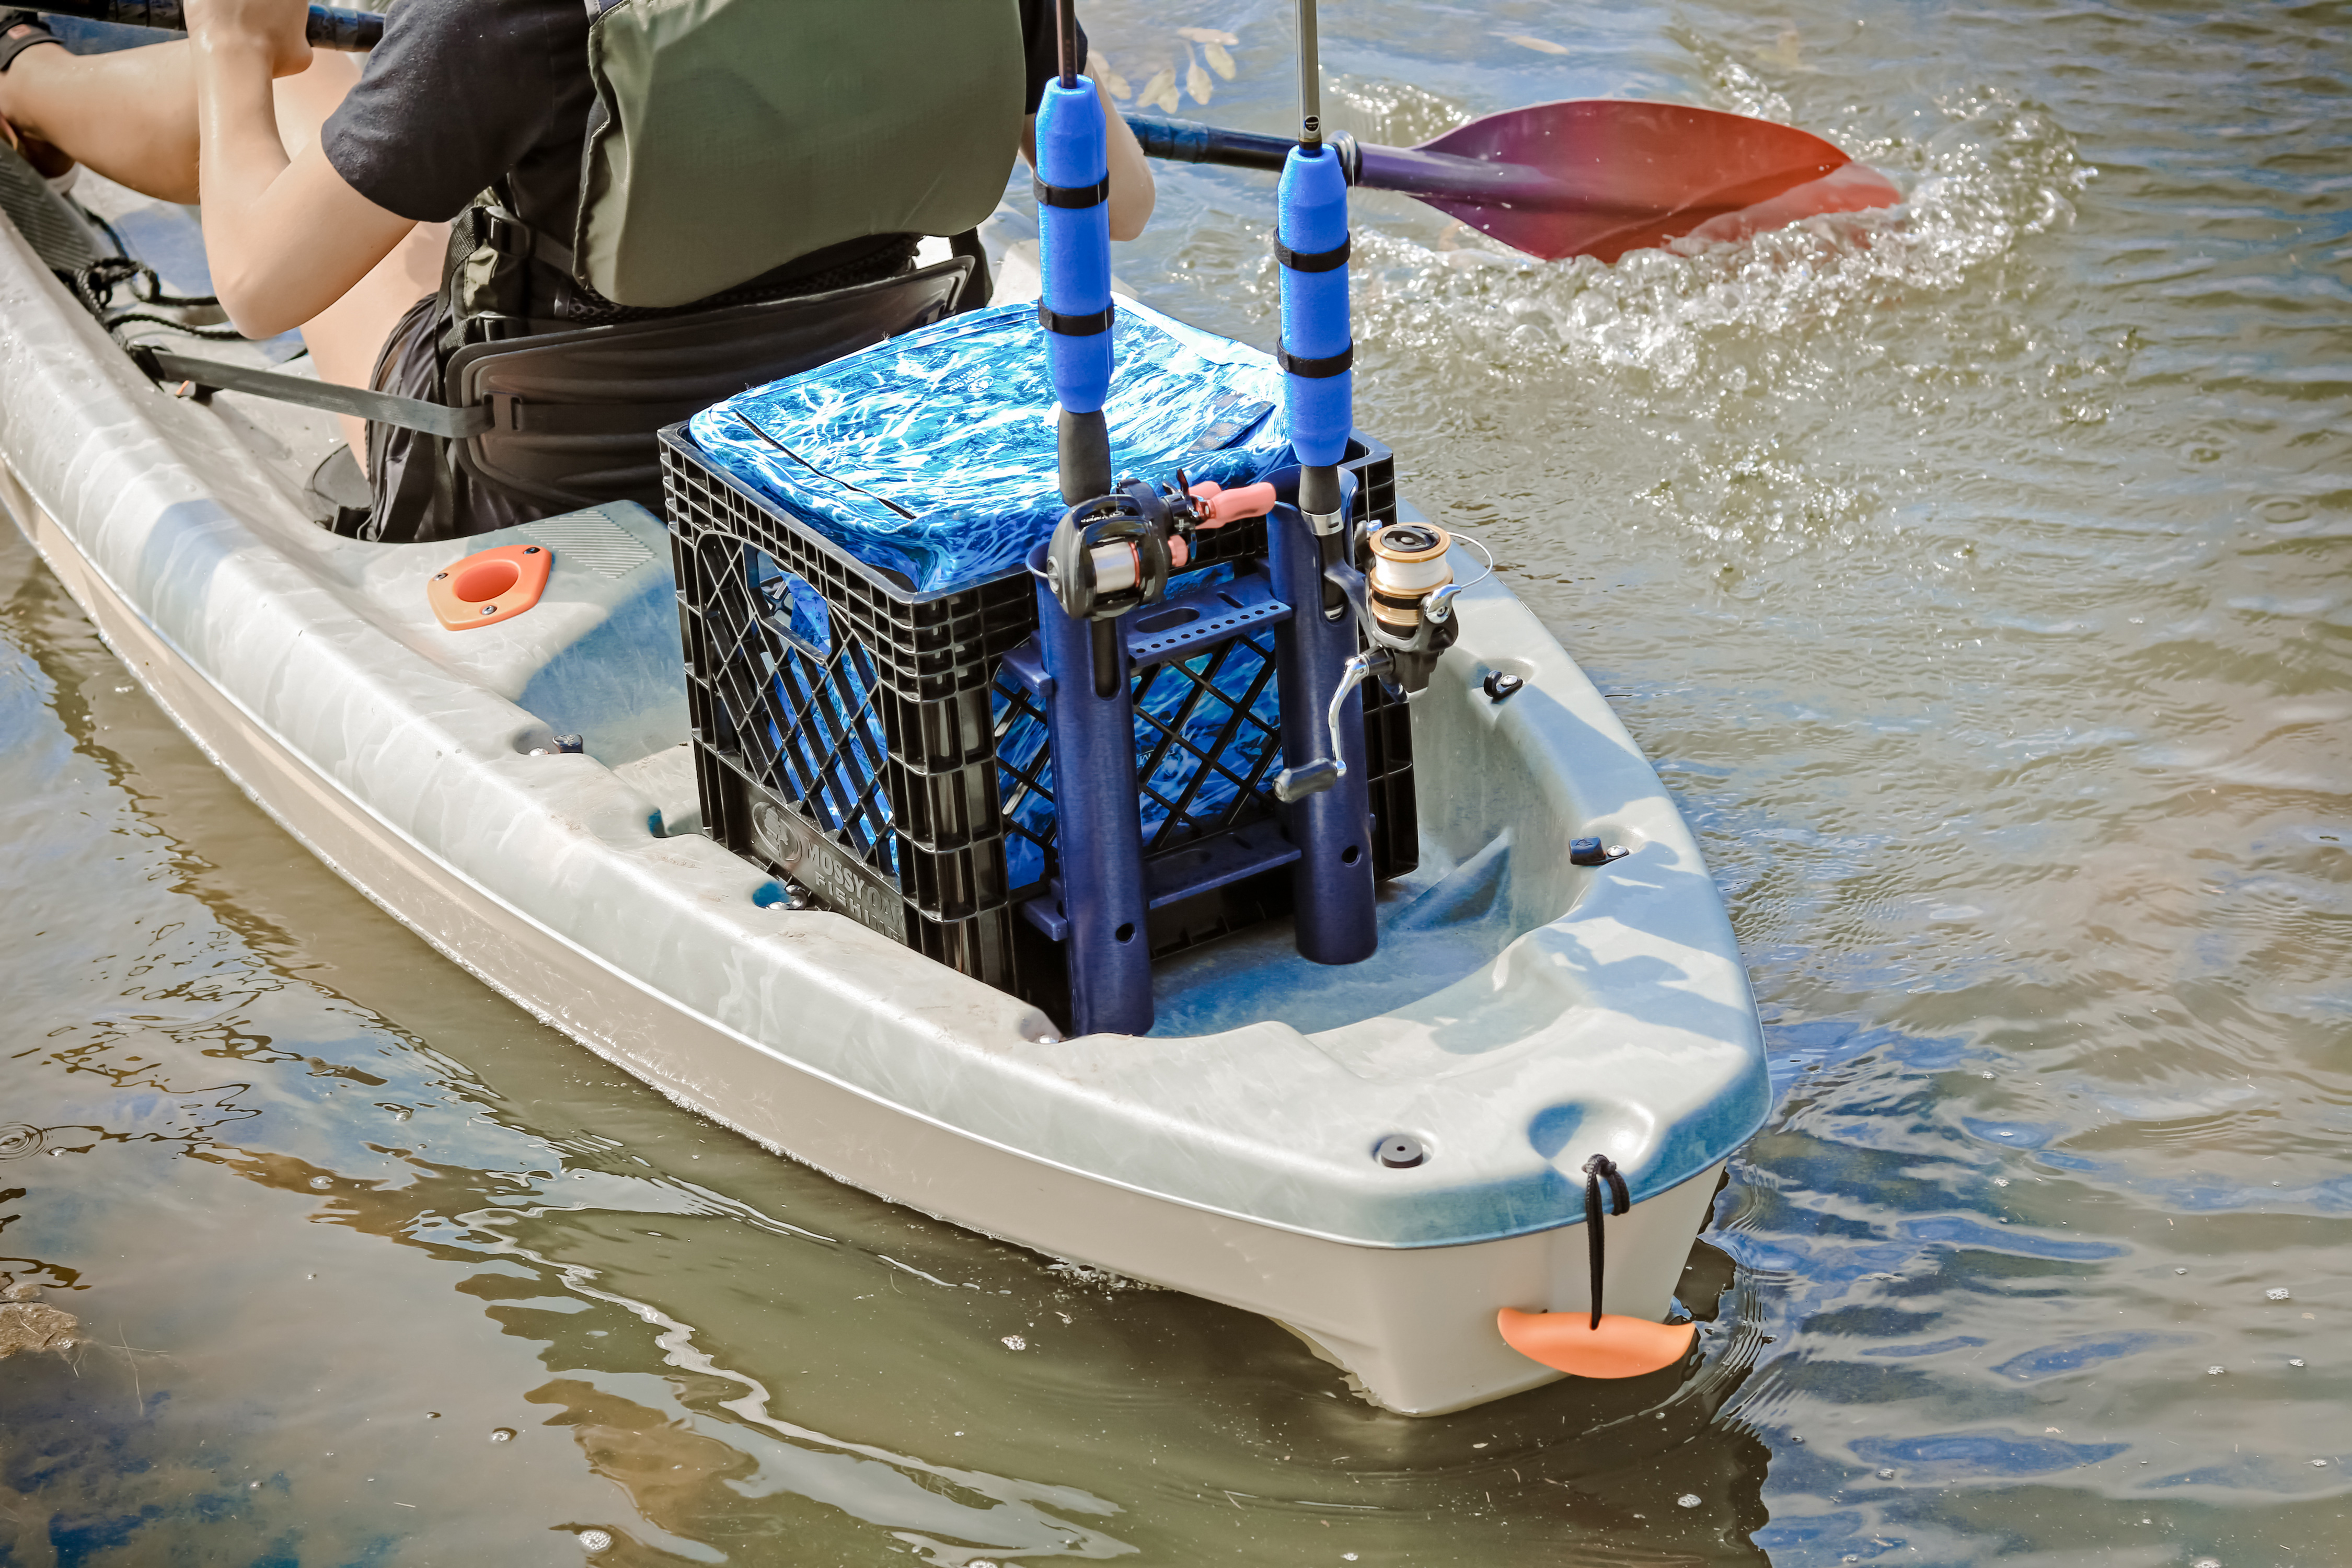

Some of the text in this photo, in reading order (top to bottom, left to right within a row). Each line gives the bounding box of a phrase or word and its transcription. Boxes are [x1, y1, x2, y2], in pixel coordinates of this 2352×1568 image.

[947, 363, 992, 392] MOSSY OAK
[804, 836, 905, 932] MOSSY OAK
